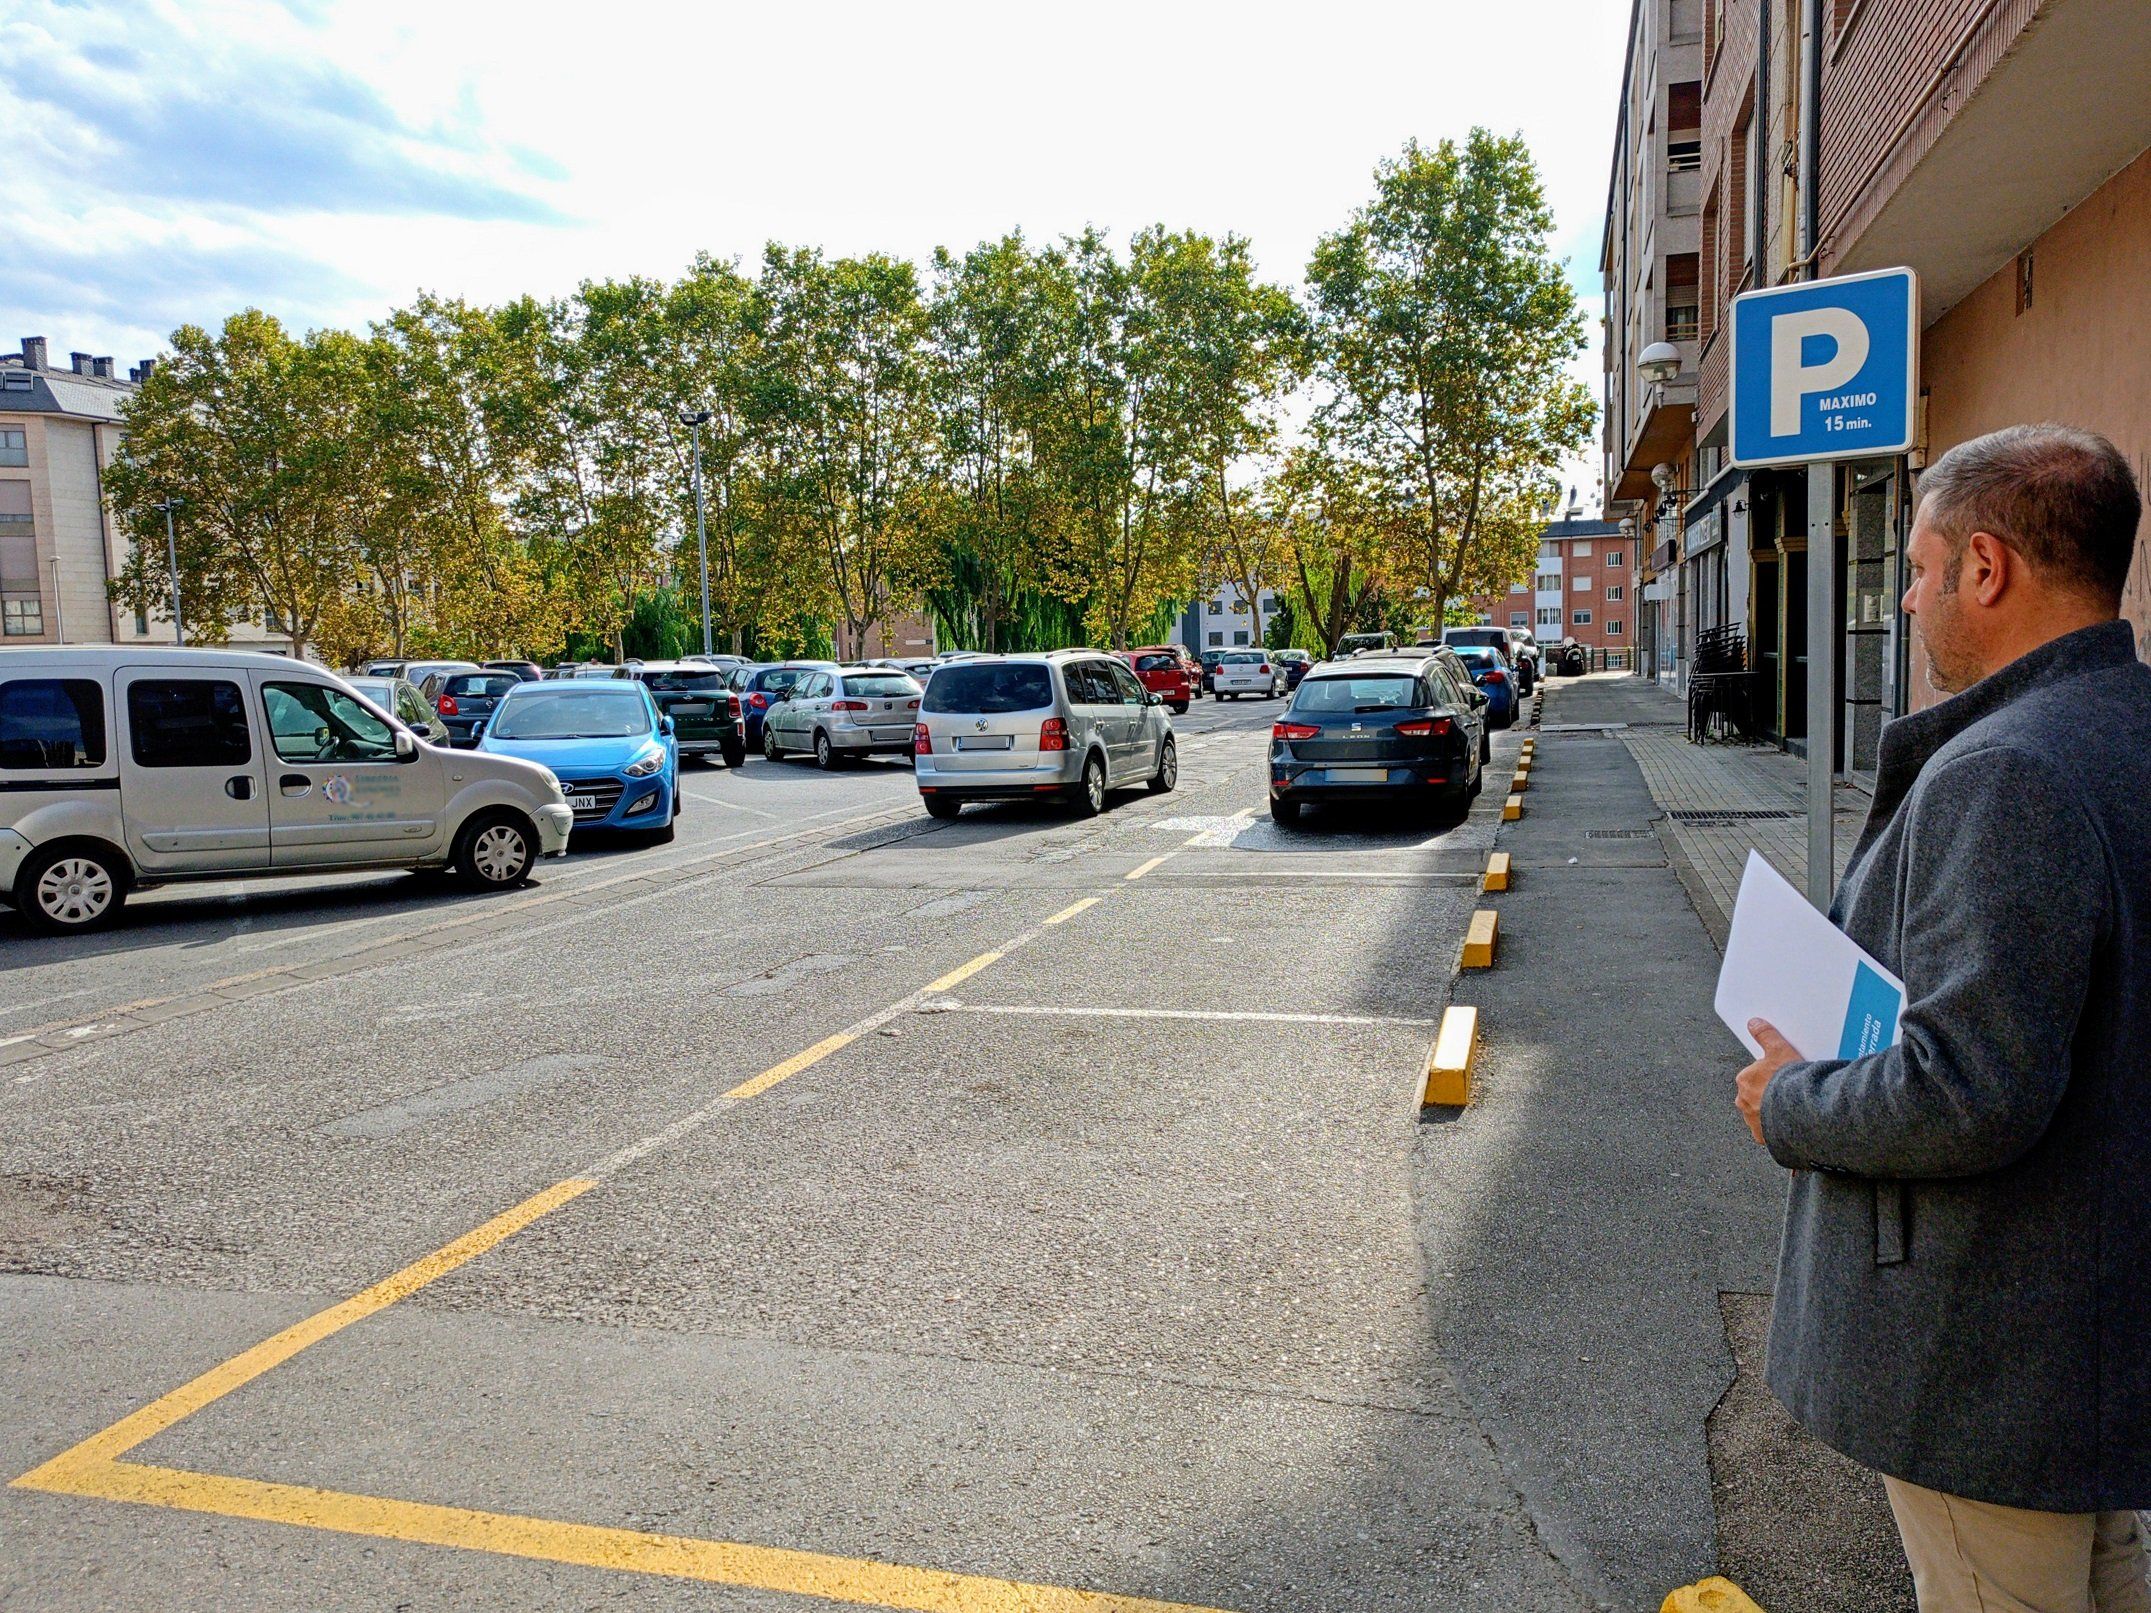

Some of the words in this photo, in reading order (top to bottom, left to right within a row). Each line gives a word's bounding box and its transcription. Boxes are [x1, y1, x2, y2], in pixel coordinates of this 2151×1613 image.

[1770, 307, 1870, 437] P
[1819, 392, 1877, 411] MAXIMO
[1824, 415, 1844, 432] 15
[1846, 417, 1872, 430] min.
[571, 797, 592, 808] JNX
[1865, 1020, 1881, 1056] errada
